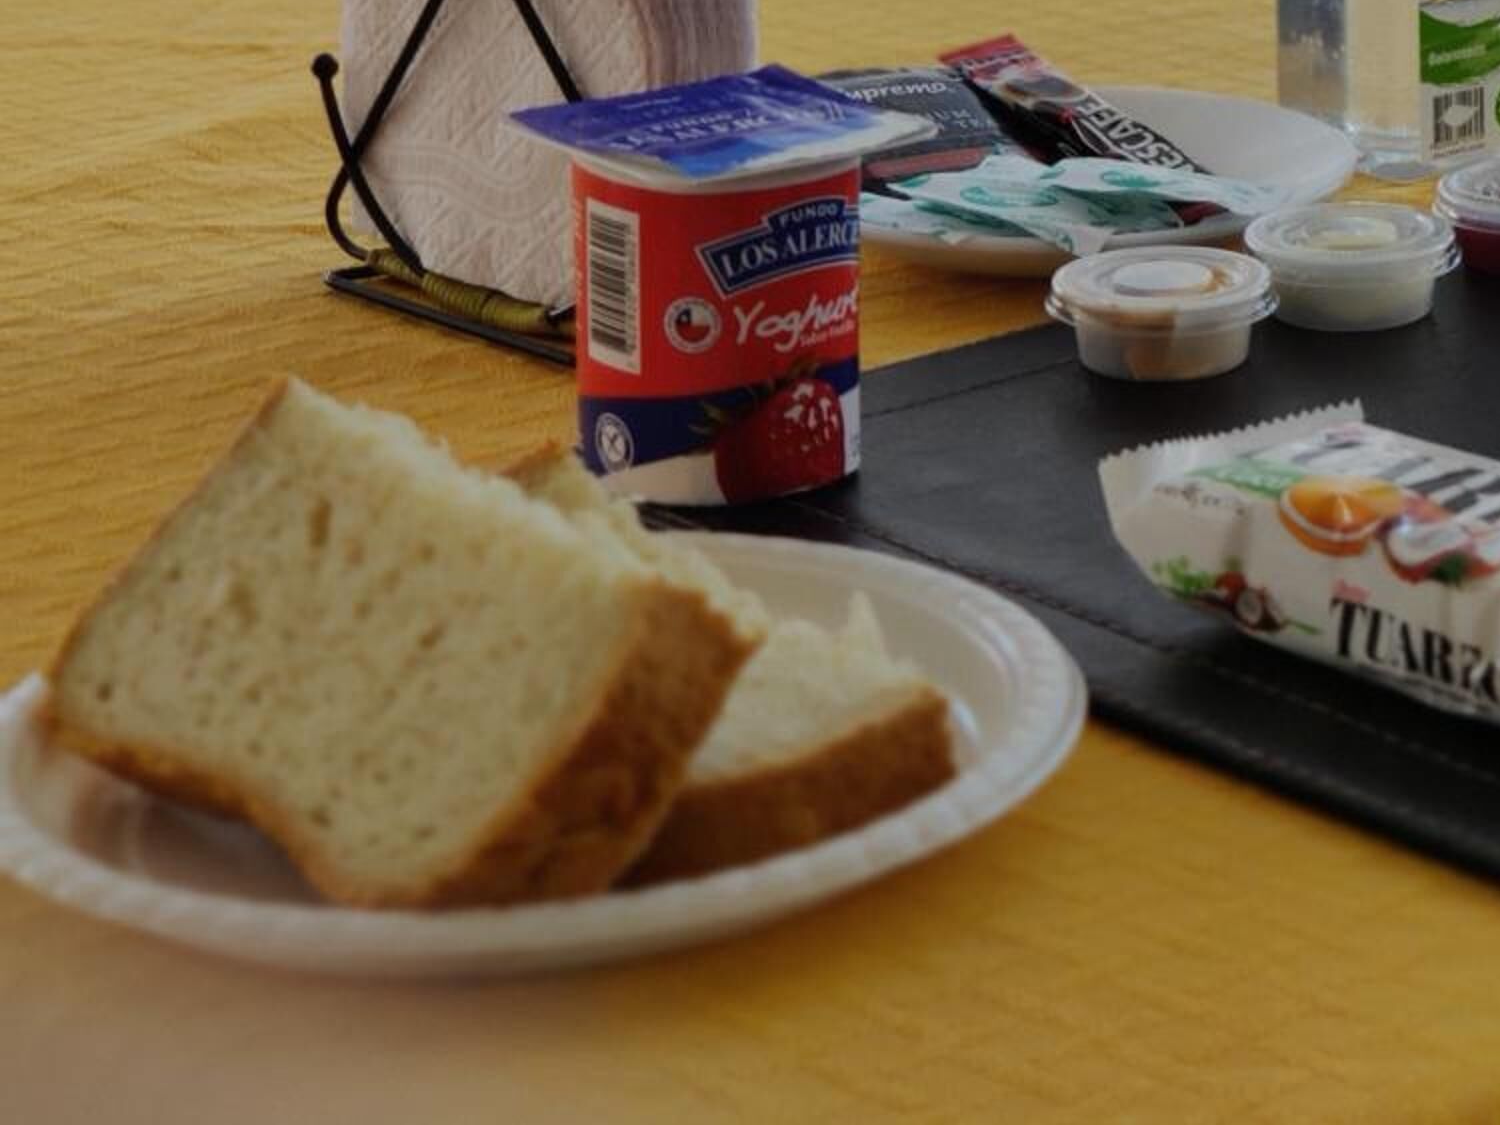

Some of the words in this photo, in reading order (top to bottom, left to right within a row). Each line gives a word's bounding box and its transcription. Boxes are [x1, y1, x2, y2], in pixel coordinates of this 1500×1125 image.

[843, 81, 947, 103] upremo
[779, 203, 838, 228] FUNDO
[721, 236, 779, 278] LOS
